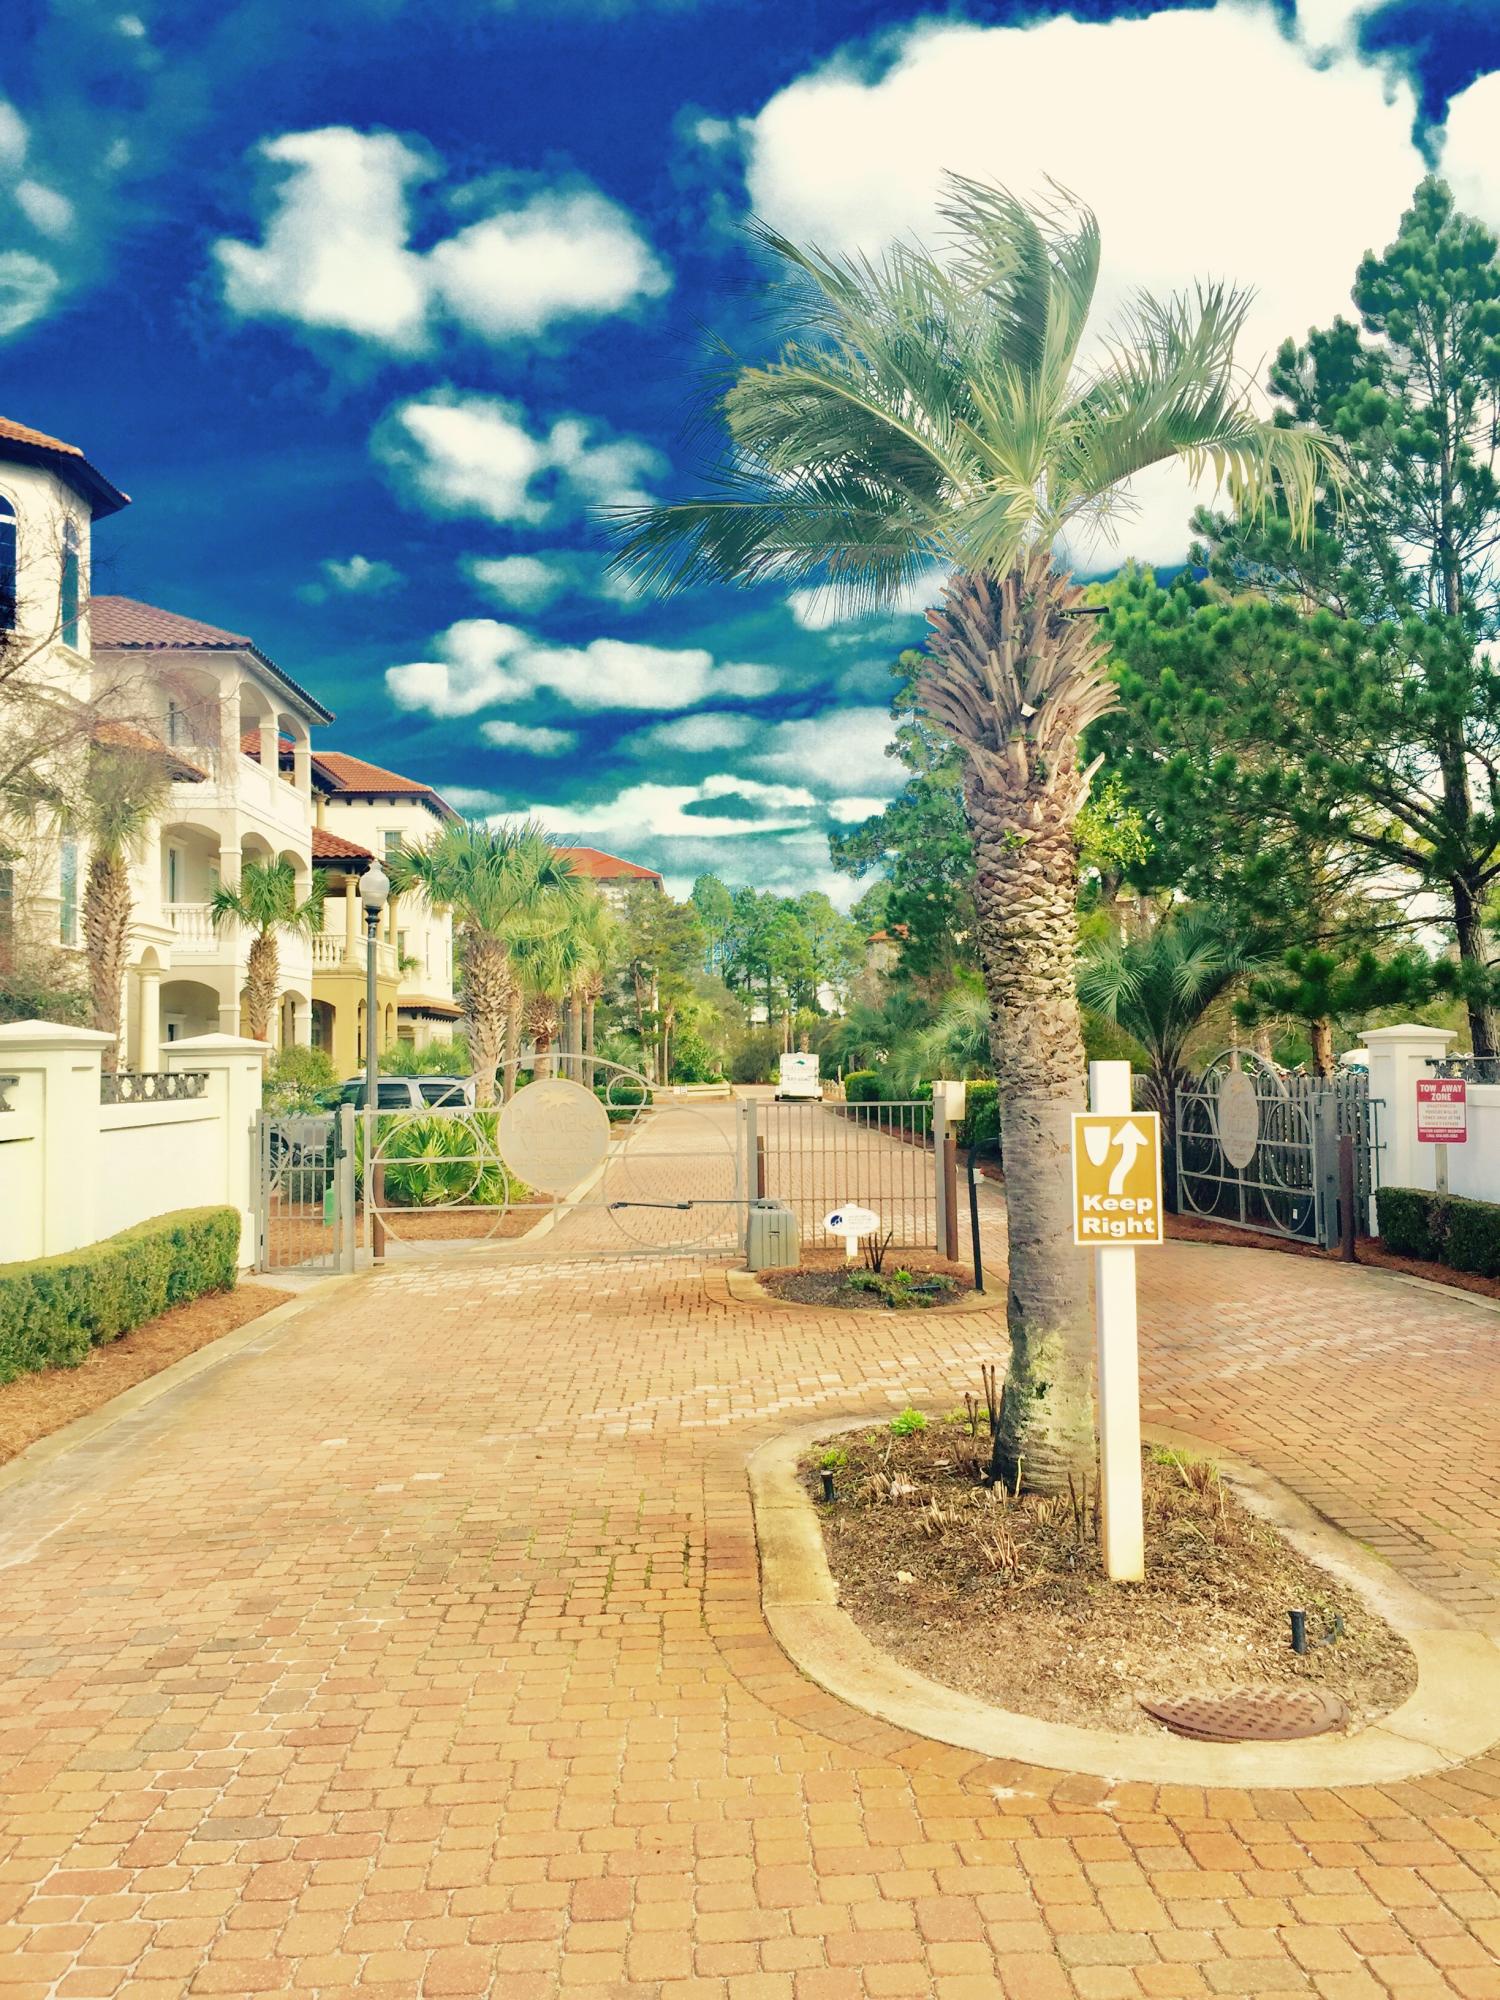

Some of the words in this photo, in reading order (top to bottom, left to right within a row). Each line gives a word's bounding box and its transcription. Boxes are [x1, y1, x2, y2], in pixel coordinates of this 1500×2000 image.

[1431, 1093, 1452, 1101] ZONE
[1083, 1194, 1153, 1215] Keep
[1082, 1217, 1155, 1237] Right
